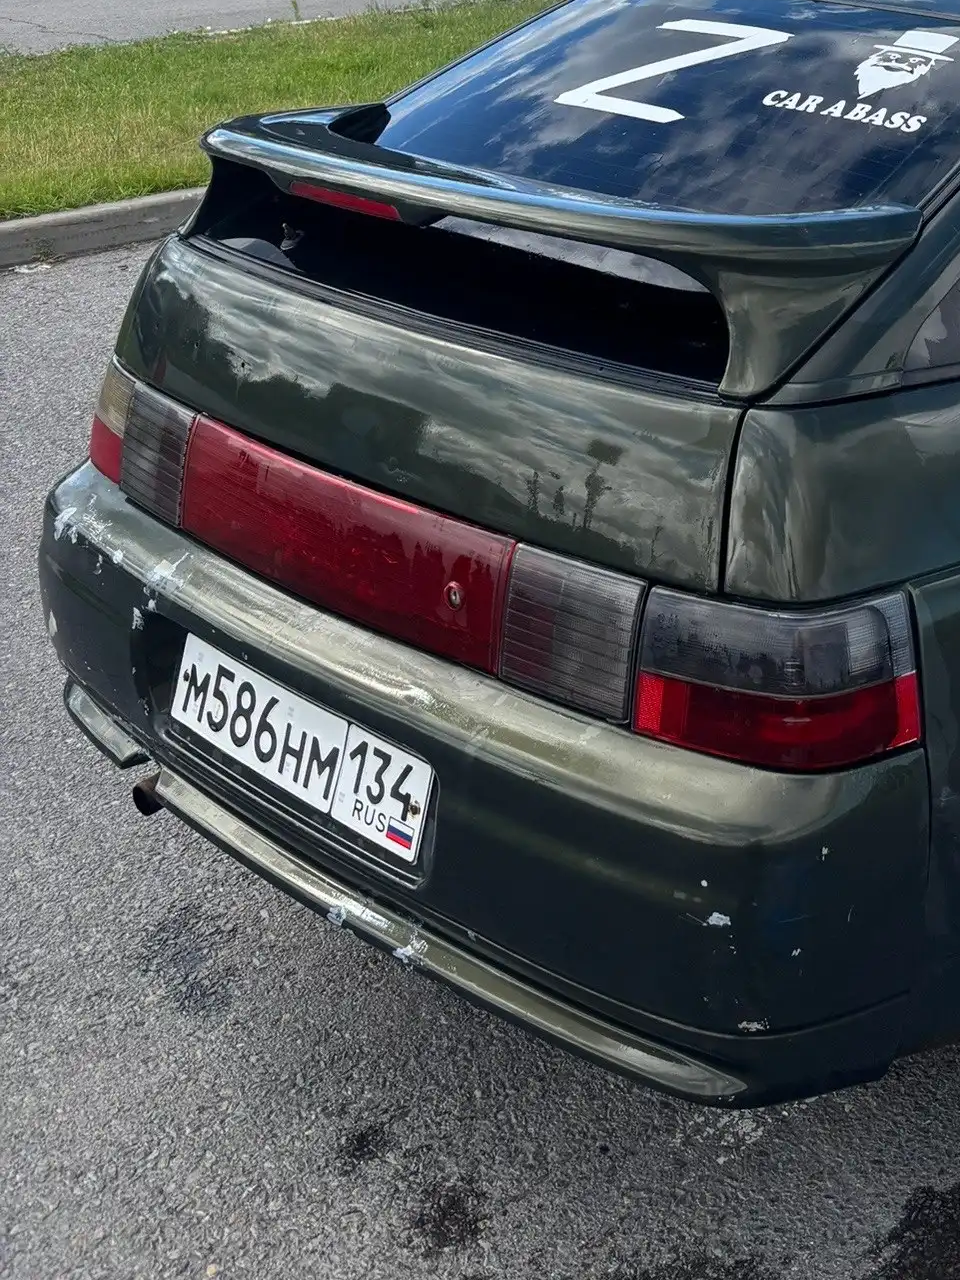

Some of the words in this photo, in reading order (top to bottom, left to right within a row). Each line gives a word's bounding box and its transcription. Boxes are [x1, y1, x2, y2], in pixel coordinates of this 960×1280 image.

[553, 18, 795, 124] Z
[762, 90, 824, 113] CAR
[181, 663, 341, 801] М586НМ
[349, 739, 417, 822] 134
[351, 800, 388, 833] RUS
